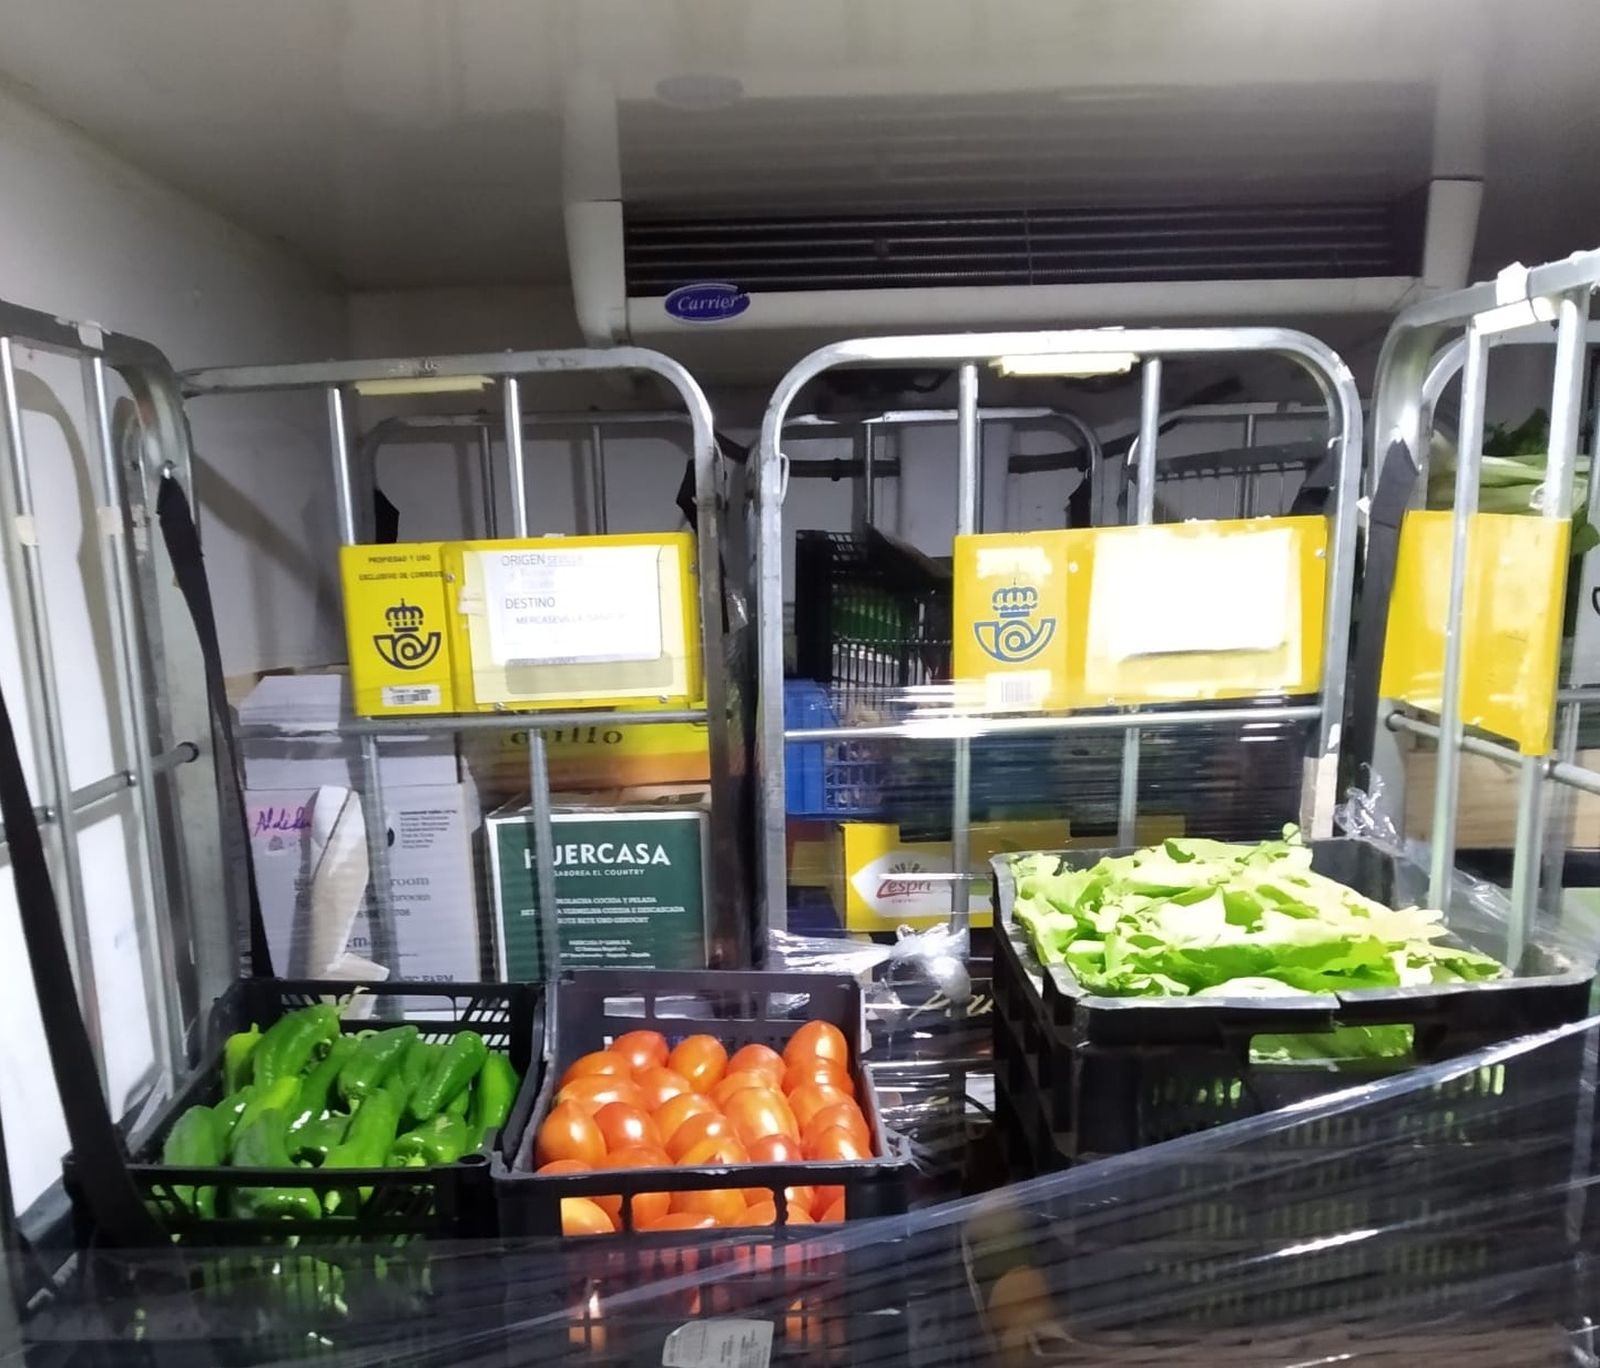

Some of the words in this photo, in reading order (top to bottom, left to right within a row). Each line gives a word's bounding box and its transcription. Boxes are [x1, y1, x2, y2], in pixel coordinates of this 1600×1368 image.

[677, 294, 739, 311] Carrier
[501, 554, 546, 567] ORIGEN
[505, 597, 556, 610] DESTINO
[604, 868, 645, 877] COUNTRY
